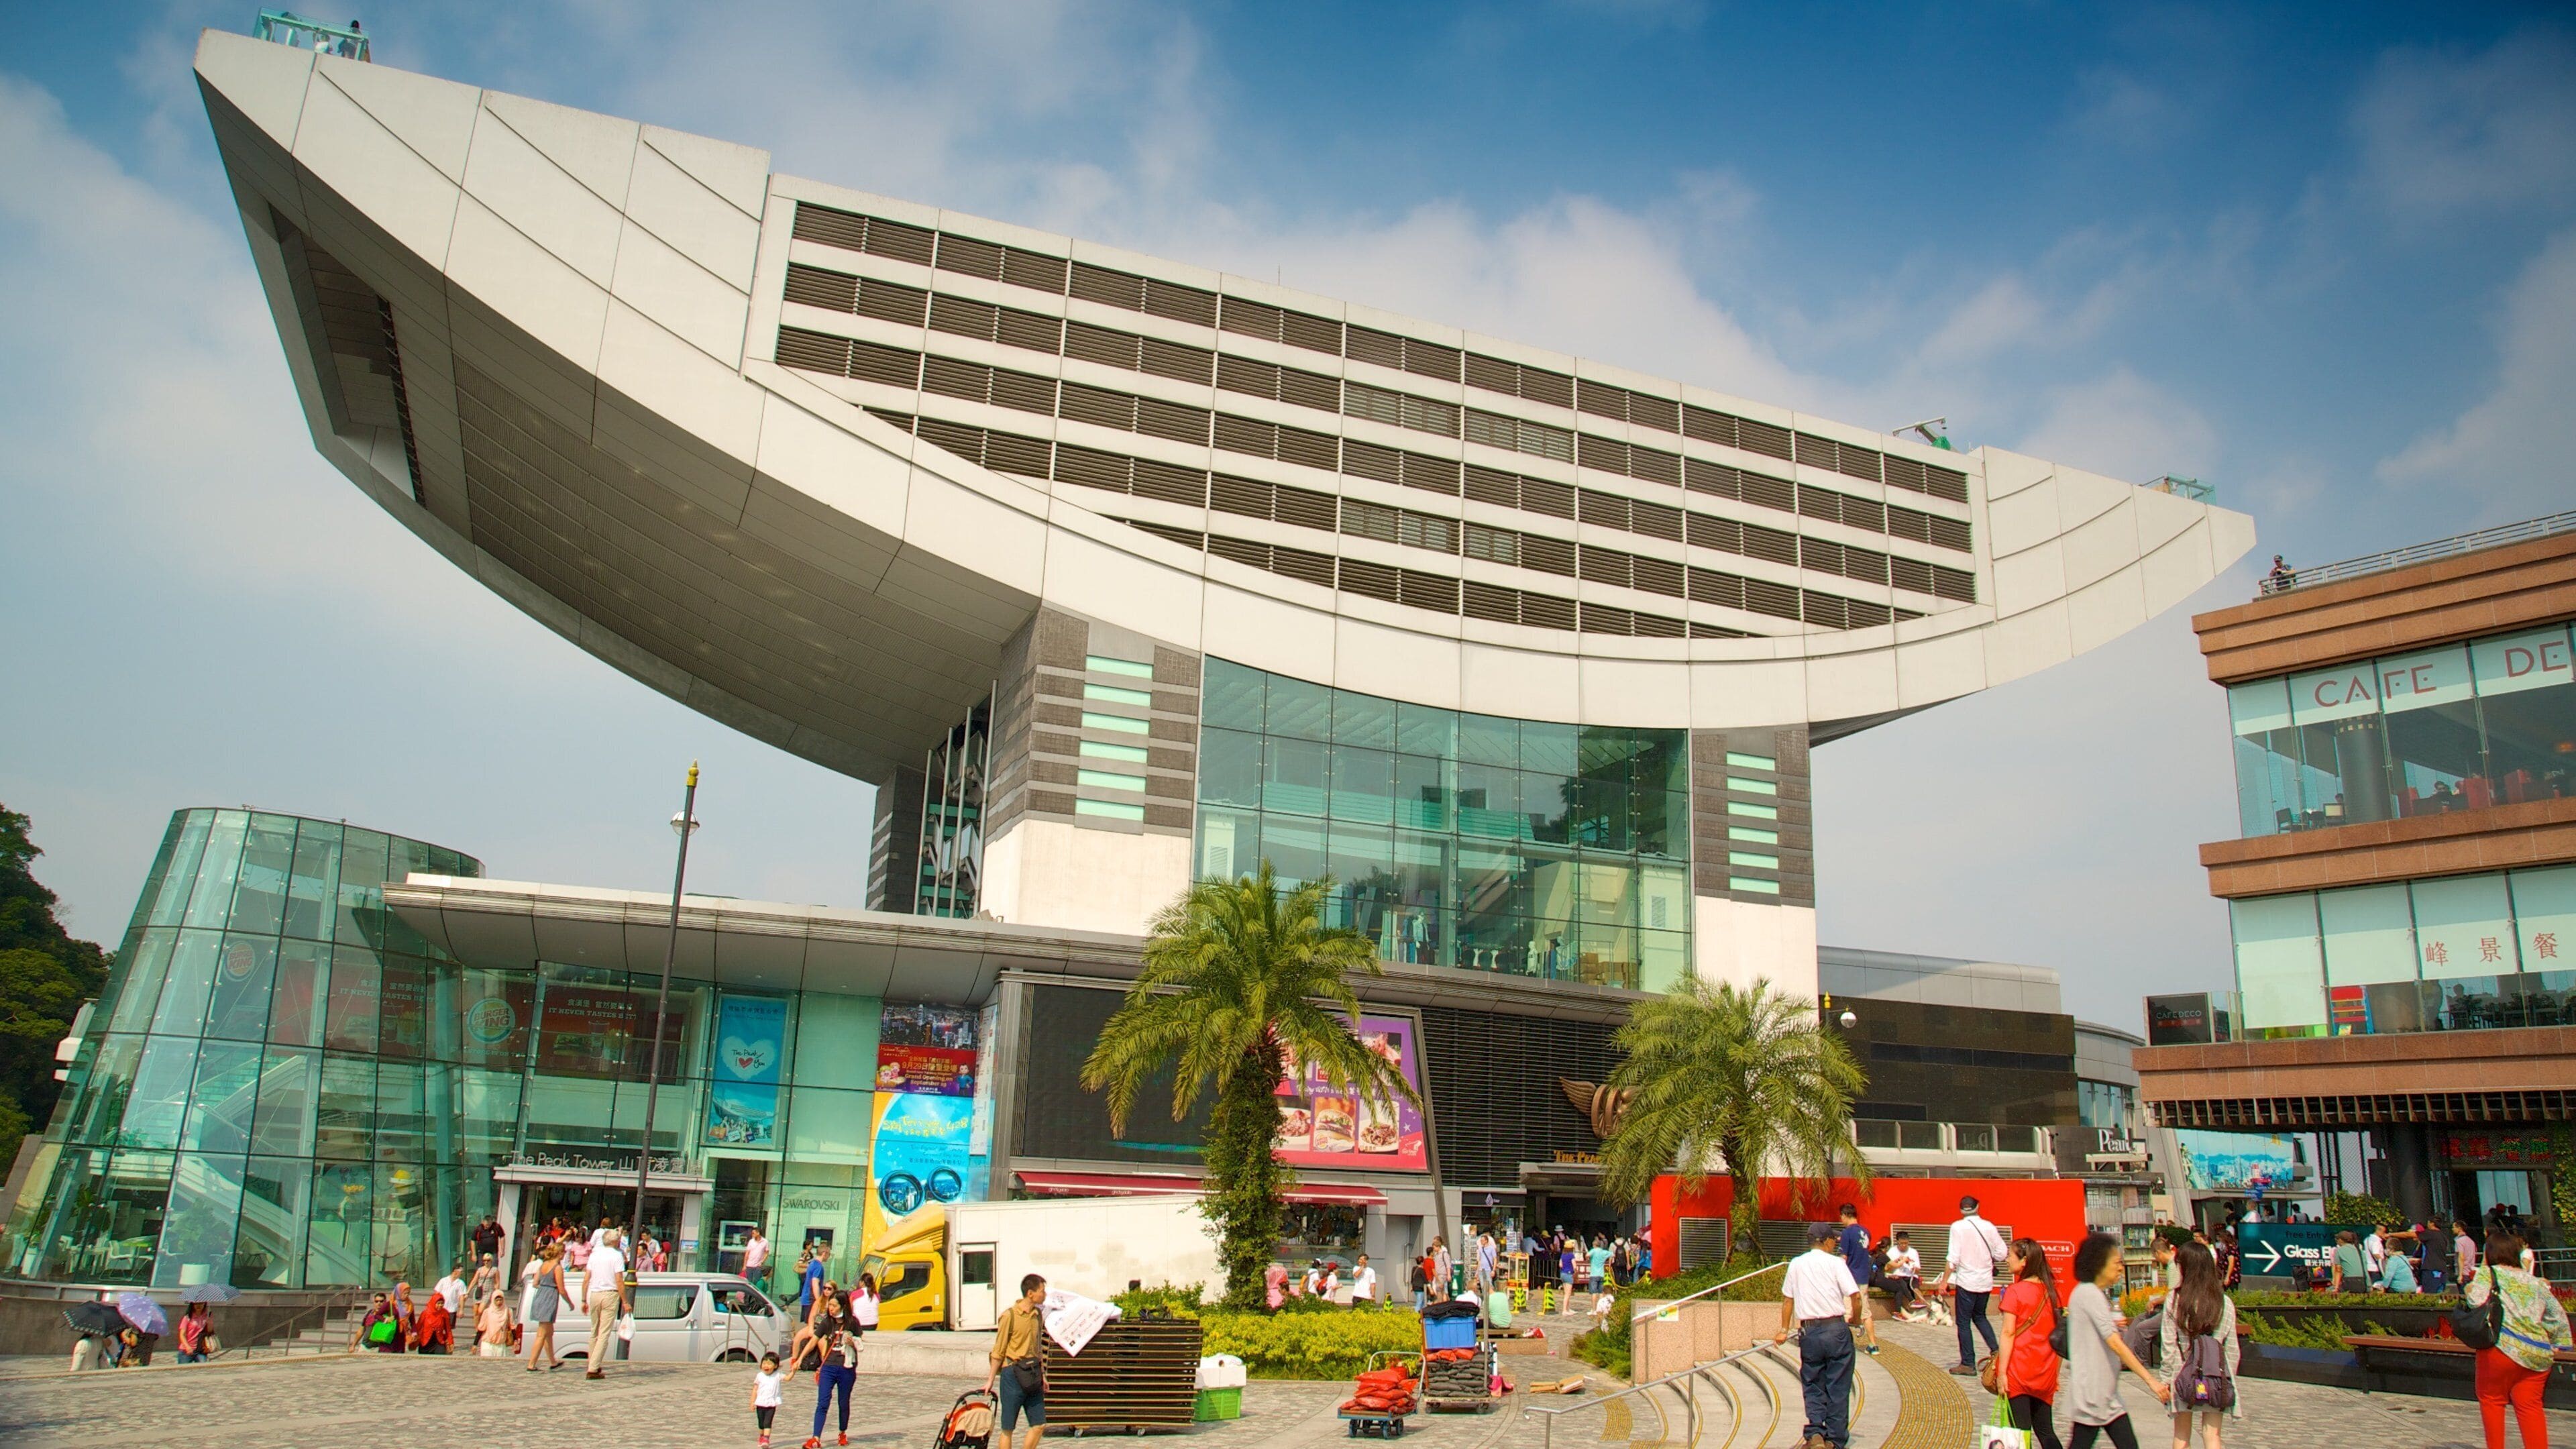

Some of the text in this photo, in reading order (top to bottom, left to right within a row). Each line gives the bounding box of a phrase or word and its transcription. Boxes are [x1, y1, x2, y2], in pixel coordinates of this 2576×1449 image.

[2314, 641, 2569, 708] CAFE DE
[2425, 932, 2559, 967] 峰景餐
[474, 1008, 509, 1020] BURGER
[558, 1008, 585, 1016] NEVER
[586, 1010, 616, 1018] TASTES
[2155, 1010, 2202, 1019] CAFE DECO
[473, 1016, 510, 1031] KING
[743, 1049, 757, 1057] Peak
[910, 1079, 942, 1087] September
[947, 1116, 969, 1132] 428
[511, 1150, 615, 1171] The Peak Tower
[782, 1198, 840, 1211] SWAROVSKI
[2041, 1244, 2070, 1252] OACH
[2284, 1244, 2320, 1259] Glass
